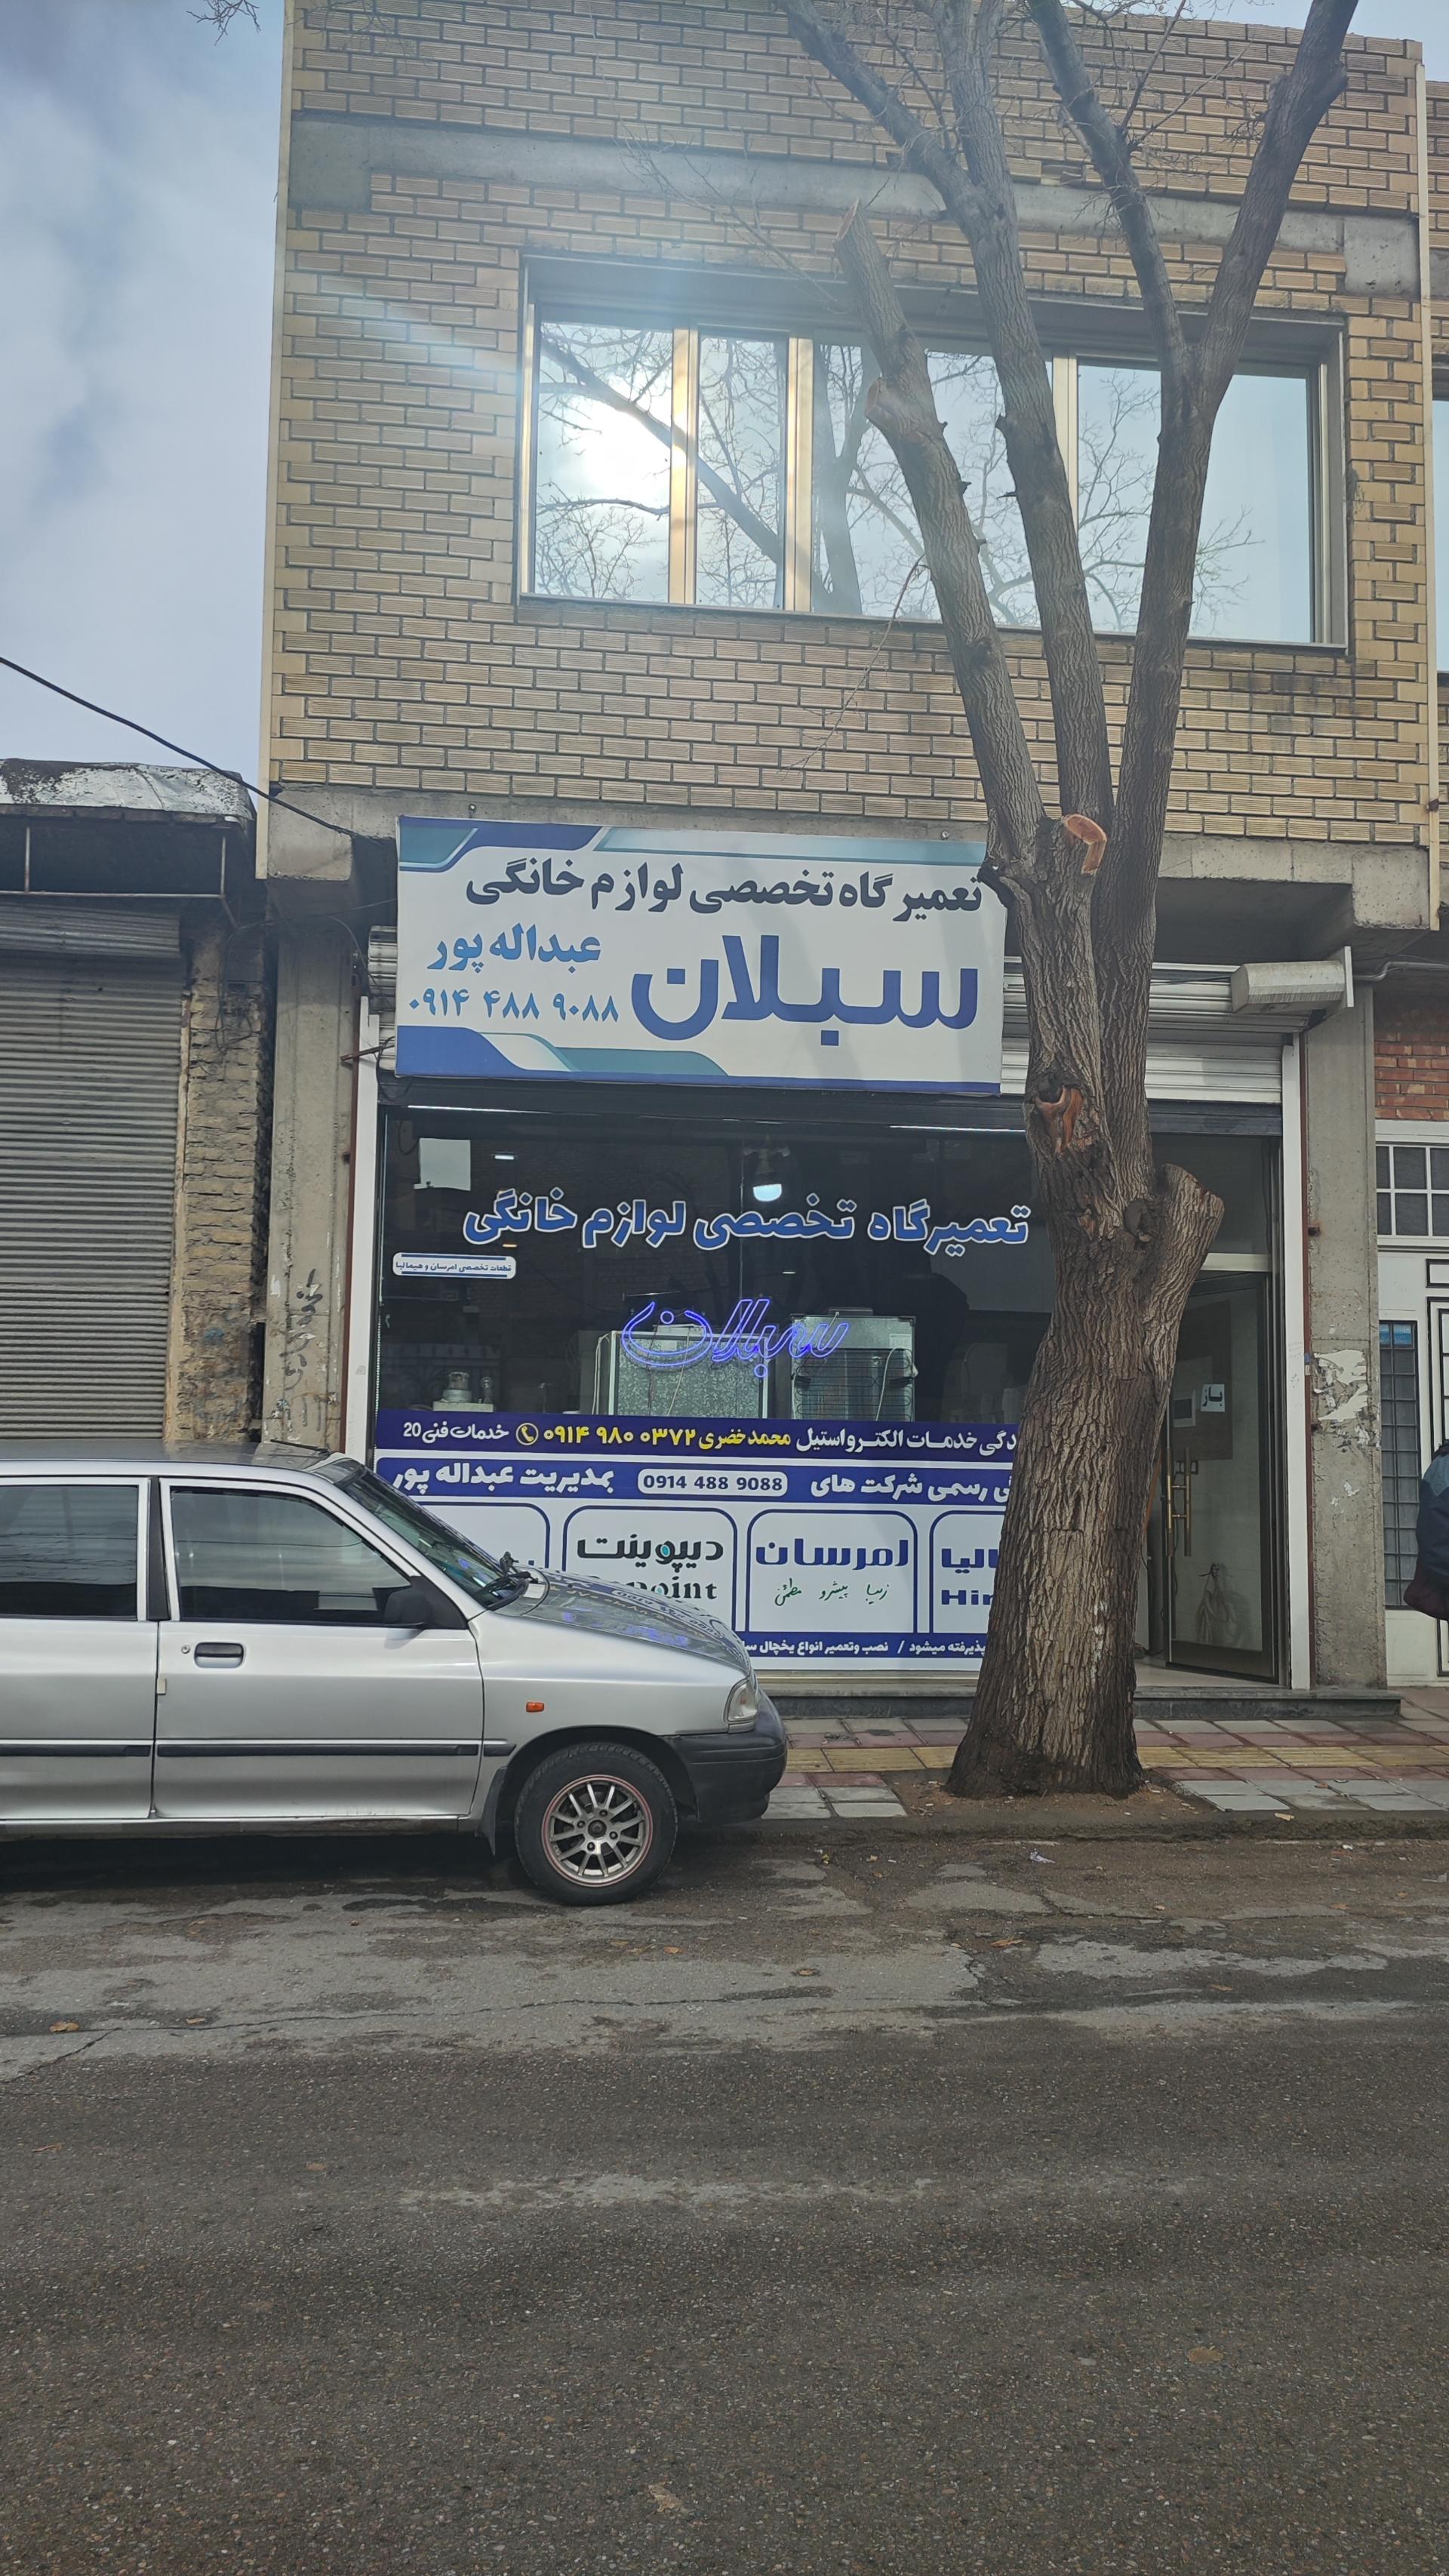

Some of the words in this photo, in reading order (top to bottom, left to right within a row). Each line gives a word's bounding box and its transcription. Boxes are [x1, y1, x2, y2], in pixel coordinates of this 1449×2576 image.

[466, 857, 585, 905] خانگی
[591, 862, 684, 913] لوازم
[690, 869, 835, 914] تخصصی
[427, 933, 484, 974] پور
[490, 922, 601, 974] عبداله
[632, 934, 978, 1046] سبلان
[409, 987, 470, 1017] ۰۹۱۴
[483, 990, 540, 1020] ۴۸۸
[552, 993, 619, 1023] ۹۰۸۸
[463, 1186, 577, 1245] خانگی
[583, 1199, 686, 1248] لوازم
[694, 1193, 857, 1250] تخصصی
[868, 1198, 1031, 1256] تعمیرگاه
[395, 1261, 423, 1270] هیمالیا
[430, 1263, 457, 1271] امرسان
[459, 1263, 488, 1273] تخصصی
[621, 1298, 849, 1378] سبلان
[403, 1421, 422, 1437] 20
[422, 1420, 449, 1444] فنی
[450, 1423, 510, 1439] خدمات
[543, 1425, 590, 1444] ۰۹۱۴
[596, 1426, 634, 1445] ۹۸۰
[640, 1427, 696, 1446] ۰۳۷۲
[698, 1428, 746, 1450] خضری
[748, 1430, 791, 1445] محمد
[906, 1430, 978, 1449] خدمات
[392, 1467, 430, 1494] پور
[435, 1462, 514, 1492] عبداله
[643, 1475, 688, 1489] 0914
[694, 1476, 729, 1490] 488
[736, 1476, 783, 1491] 9088
[811, 1473, 856, 1497] های
[860, 1473, 922, 1501] شرکت
[928, 1482, 988, 1503] رسمی
[577, 1533, 724, 1572] دیپوینت
[755, 1537, 909, 1571] امرسان
[818, 1580, 848, 1602] پیشرو
[866, 1583, 890, 1605] زیبا
[759, 1639, 795, 1655] یخچال
[797, 1641, 823, 1656] انواع
[862, 1641, 889, 1655] نصب
[909, 1640, 946, 1654] میشود
